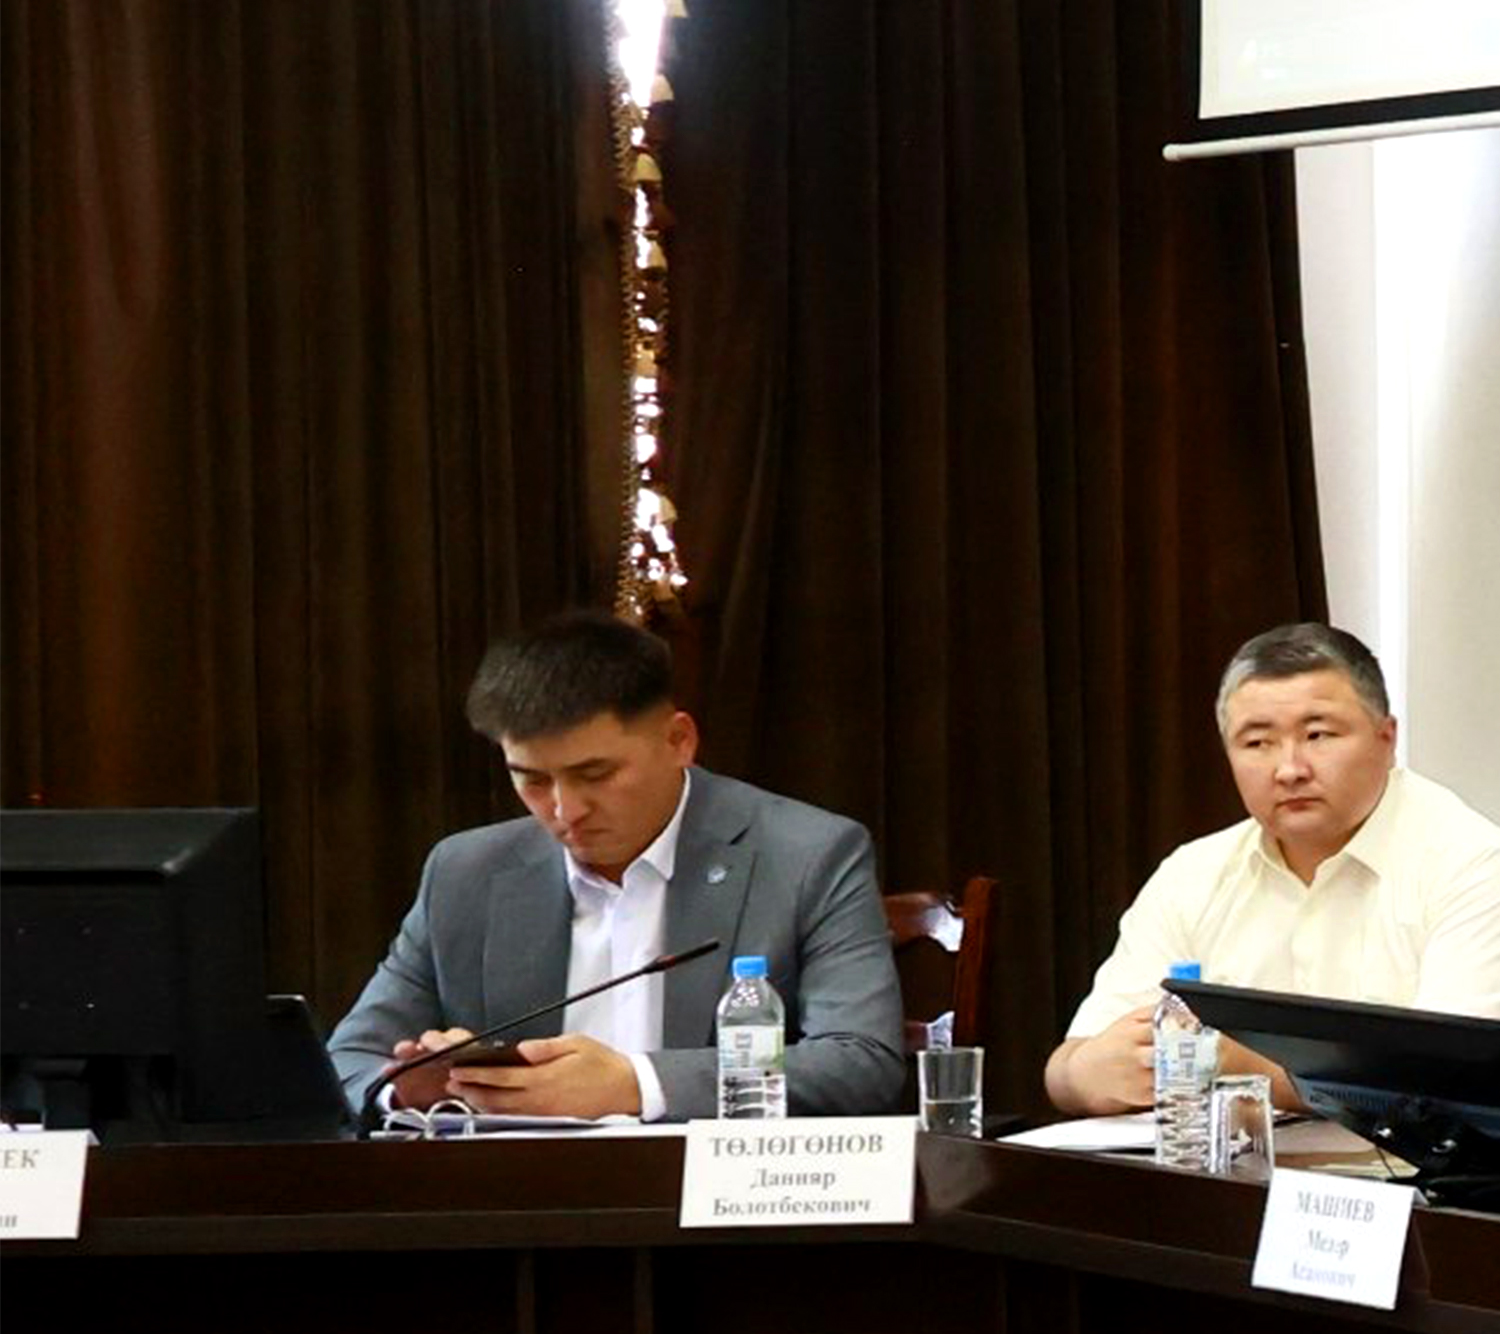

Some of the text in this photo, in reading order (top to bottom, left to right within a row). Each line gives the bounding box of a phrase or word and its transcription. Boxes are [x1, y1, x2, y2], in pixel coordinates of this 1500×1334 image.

[709, 1134, 883, 1157] ТӨЛӨГӨНОВ
[0, 1149, 40, 1169] ЕК
[750, 1168, 836, 1190] Данияр
[713, 1196, 871, 1216] Болотбекович
